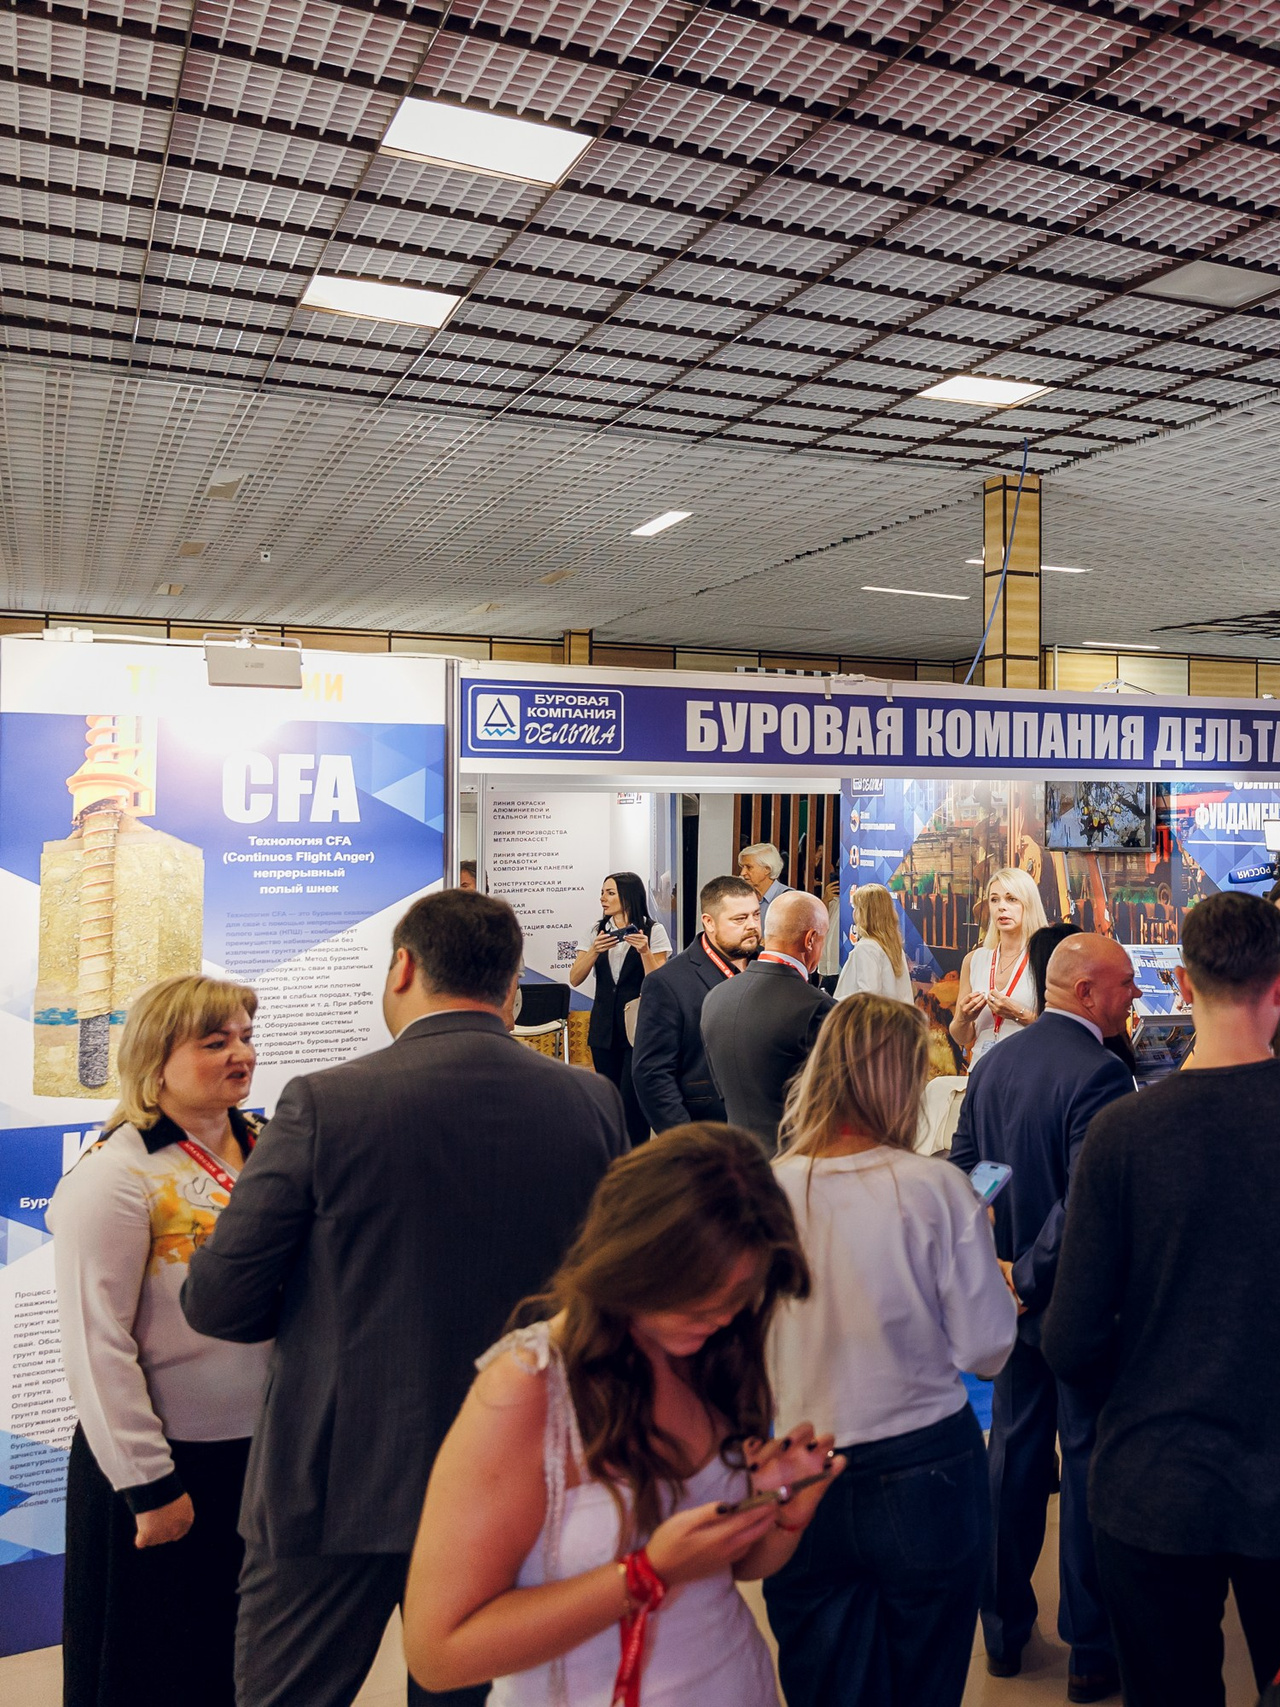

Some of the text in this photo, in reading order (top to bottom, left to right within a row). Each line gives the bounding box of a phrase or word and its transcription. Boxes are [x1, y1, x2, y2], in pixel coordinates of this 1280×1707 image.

[534, 693, 609, 707] БУРОВАЯ
[526, 707, 617, 720] КОМПАНИЯ
[524, 721, 615, 747] ДЕЛЬТА
[686, 700, 903, 755] БУРОВАЯ
[915, 707, 1144, 760] КОМПАНИЯ
[221, 750, 361, 824] CFA
[248, 835, 352, 847] Технология CFA
[222, 851, 375, 864] (Continuos Flight Anger)
[253, 867, 345, 879] непрерывный
[1236, 866, 1272, 880] РОССИЯ
[259, 883, 339, 894] полый шнек
[493, 887, 545, 895] ДИЗАЙНЕРСКАЯ
[14, 1309, 59, 1319] наконечни
[12, 1367, 65, 1379] телескопиче
